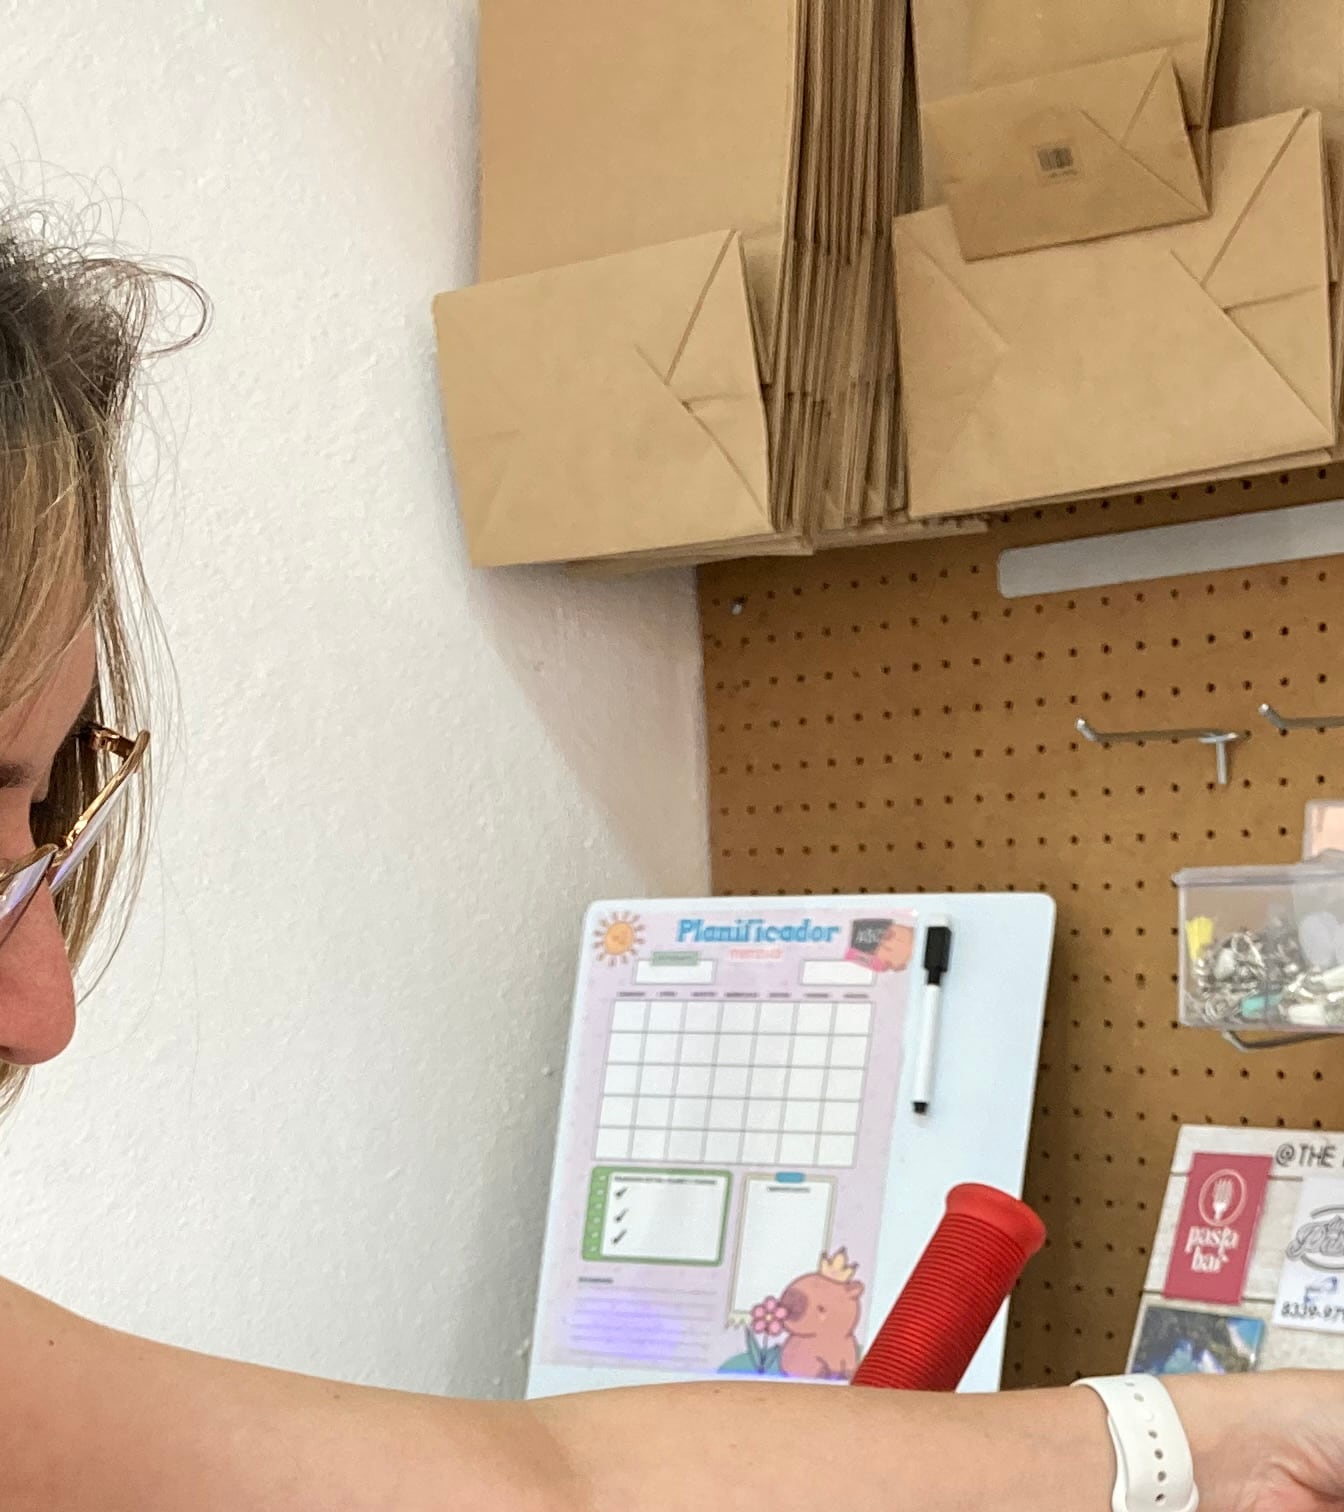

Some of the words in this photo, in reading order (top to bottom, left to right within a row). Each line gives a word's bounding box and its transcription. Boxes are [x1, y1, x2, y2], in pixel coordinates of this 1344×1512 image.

[676, 918, 841, 943] Planificador
[1275, 1142, 1337, 1169] @THE
[1184, 1226, 1240, 1262] pasta
